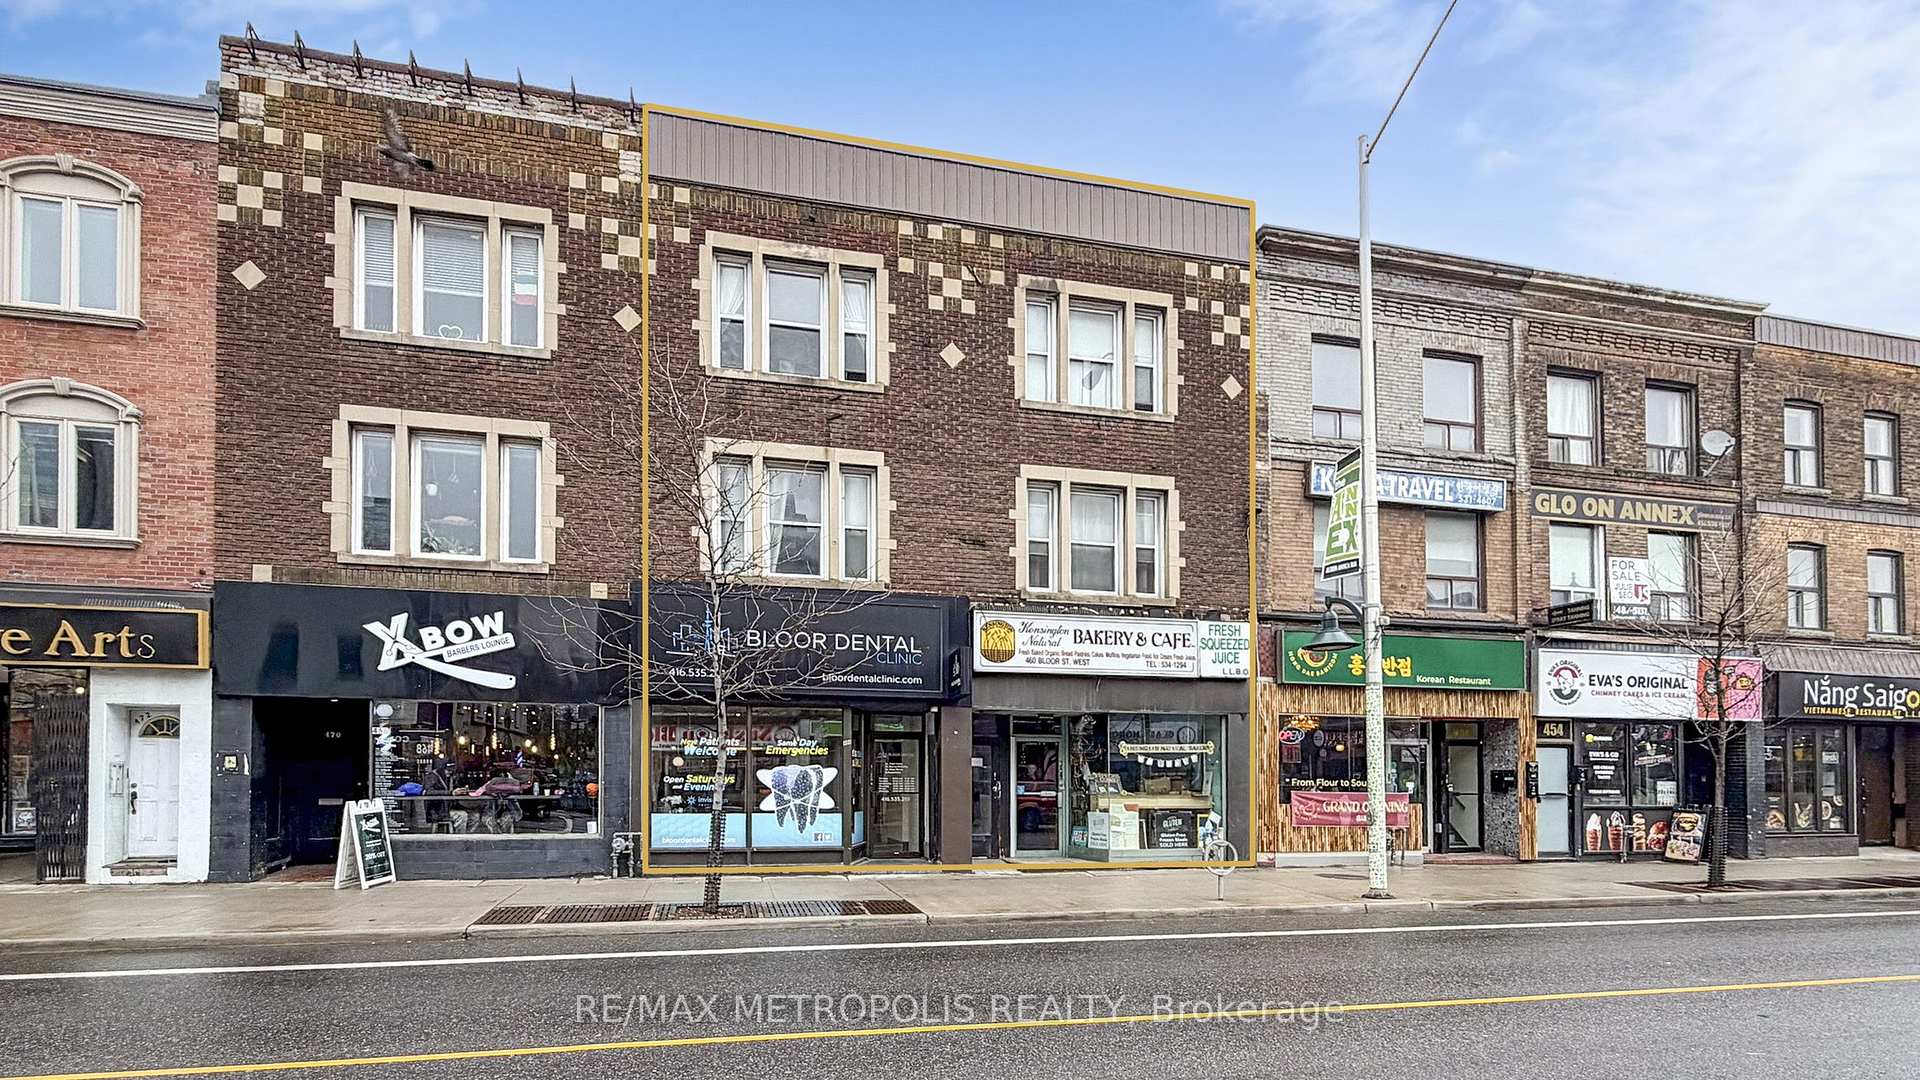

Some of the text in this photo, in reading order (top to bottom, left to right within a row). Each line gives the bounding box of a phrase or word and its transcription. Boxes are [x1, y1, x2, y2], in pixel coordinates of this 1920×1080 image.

[1388, 475, 1454, 502] TRAVEL
[1535, 493, 1577, 515] GLO
[1582, 497, 1615, 518] ON
[1619, 501, 1695, 526] ANNEX
[1611, 559, 1636, 570] FOR
[1612, 571, 1641, 581] SALE
[1208, 624, 1241, 637] FRESH
[44, 619, 156, 658] Arts
[746, 630, 922, 653] BLOOR DENTAL
[1073, 629, 1191, 649] BAKERY & CAFE
[1199, 637, 1250, 651] SQUEEZED
[446, 636, 511, 657] BARBERS LOUNGE
[876, 652, 923, 665] CLINIC
[1211, 652, 1240, 664] JUICE
[1348, 653, 1413, 678] 홍반점
[822, 673, 923, 685] bloordentalclinic.com
[1416, 675, 1491, 686] Korean Restaurant
[1588, 674, 1623, 688] EVA'S
[1626, 675, 1689, 690] ORIGINAL
[1803, 707, 1851, 716] VIETNAMESE
[1855, 708, 1902, 717] RESTAURANT
[1543, 724, 1564, 736] 454
[699, 737, 740, 746] Patints
[799, 738, 818, 748] Day
[684, 745, 737, 757] Welcoe
[765, 745, 829, 757] Emergencies
[663, 775, 685, 785] Open
[1316, 778, 1338, 787] Flour
[1340, 779, 1349, 787] to
[1350, 779, 1368, 787] Sou
[1322, 801, 1409, 813] GRAND ONING
